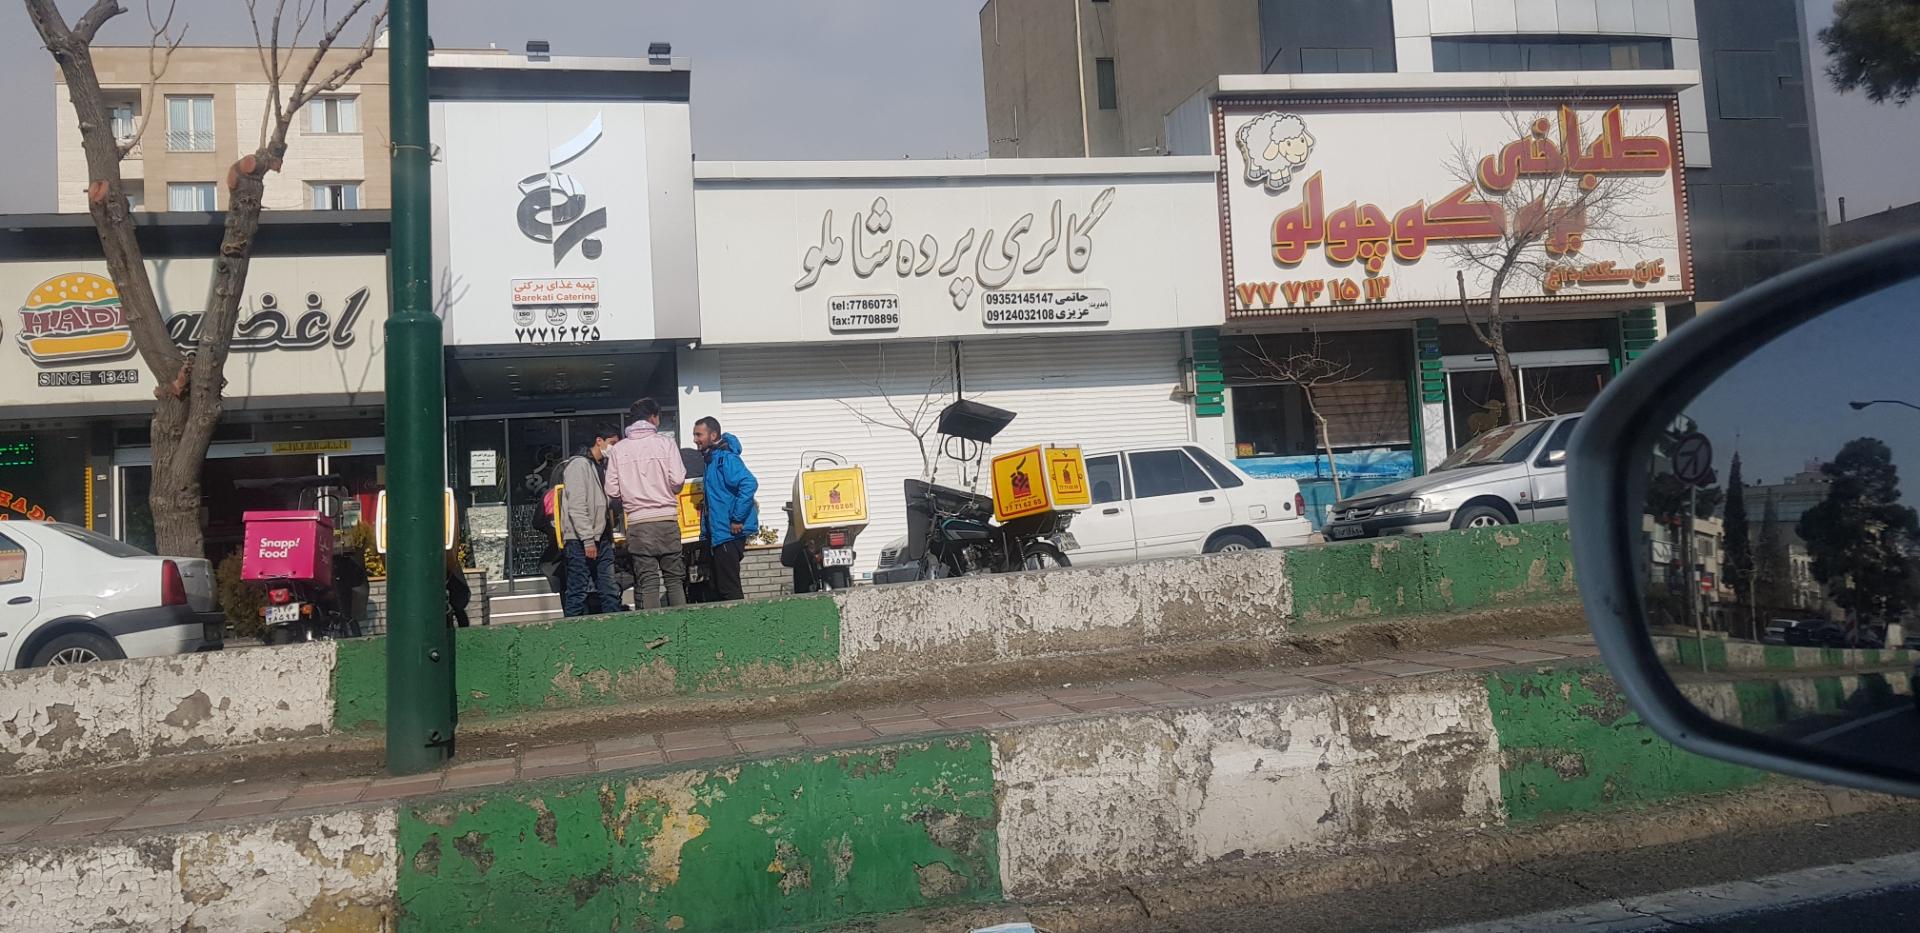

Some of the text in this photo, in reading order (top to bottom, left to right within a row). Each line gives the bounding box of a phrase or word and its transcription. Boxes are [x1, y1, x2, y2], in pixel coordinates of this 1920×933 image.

[1477, 104, 1672, 192] طباخی
[1271, 169, 1508, 273] کوچولو
[794, 186, 1116, 310] گالری پرده شاملو
[514, 280, 544, 293] برکتی
[547, 279, 573, 291] غذای
[514, 292, 596, 302] Barekati Catering
[985, 292, 1089, 306] حاتمی 09352145147
[831, 299, 899, 311] tel:77860731
[831, 313, 899, 326] fax:77708896
[985, 307, 1090, 321] عزیزی 09124032108
[39, 370, 137, 386] SINCE 1348
[0, 489, 56, 524] HAD
[260, 537, 301, 549] Snapp!
[259, 548, 288, 559] Food
